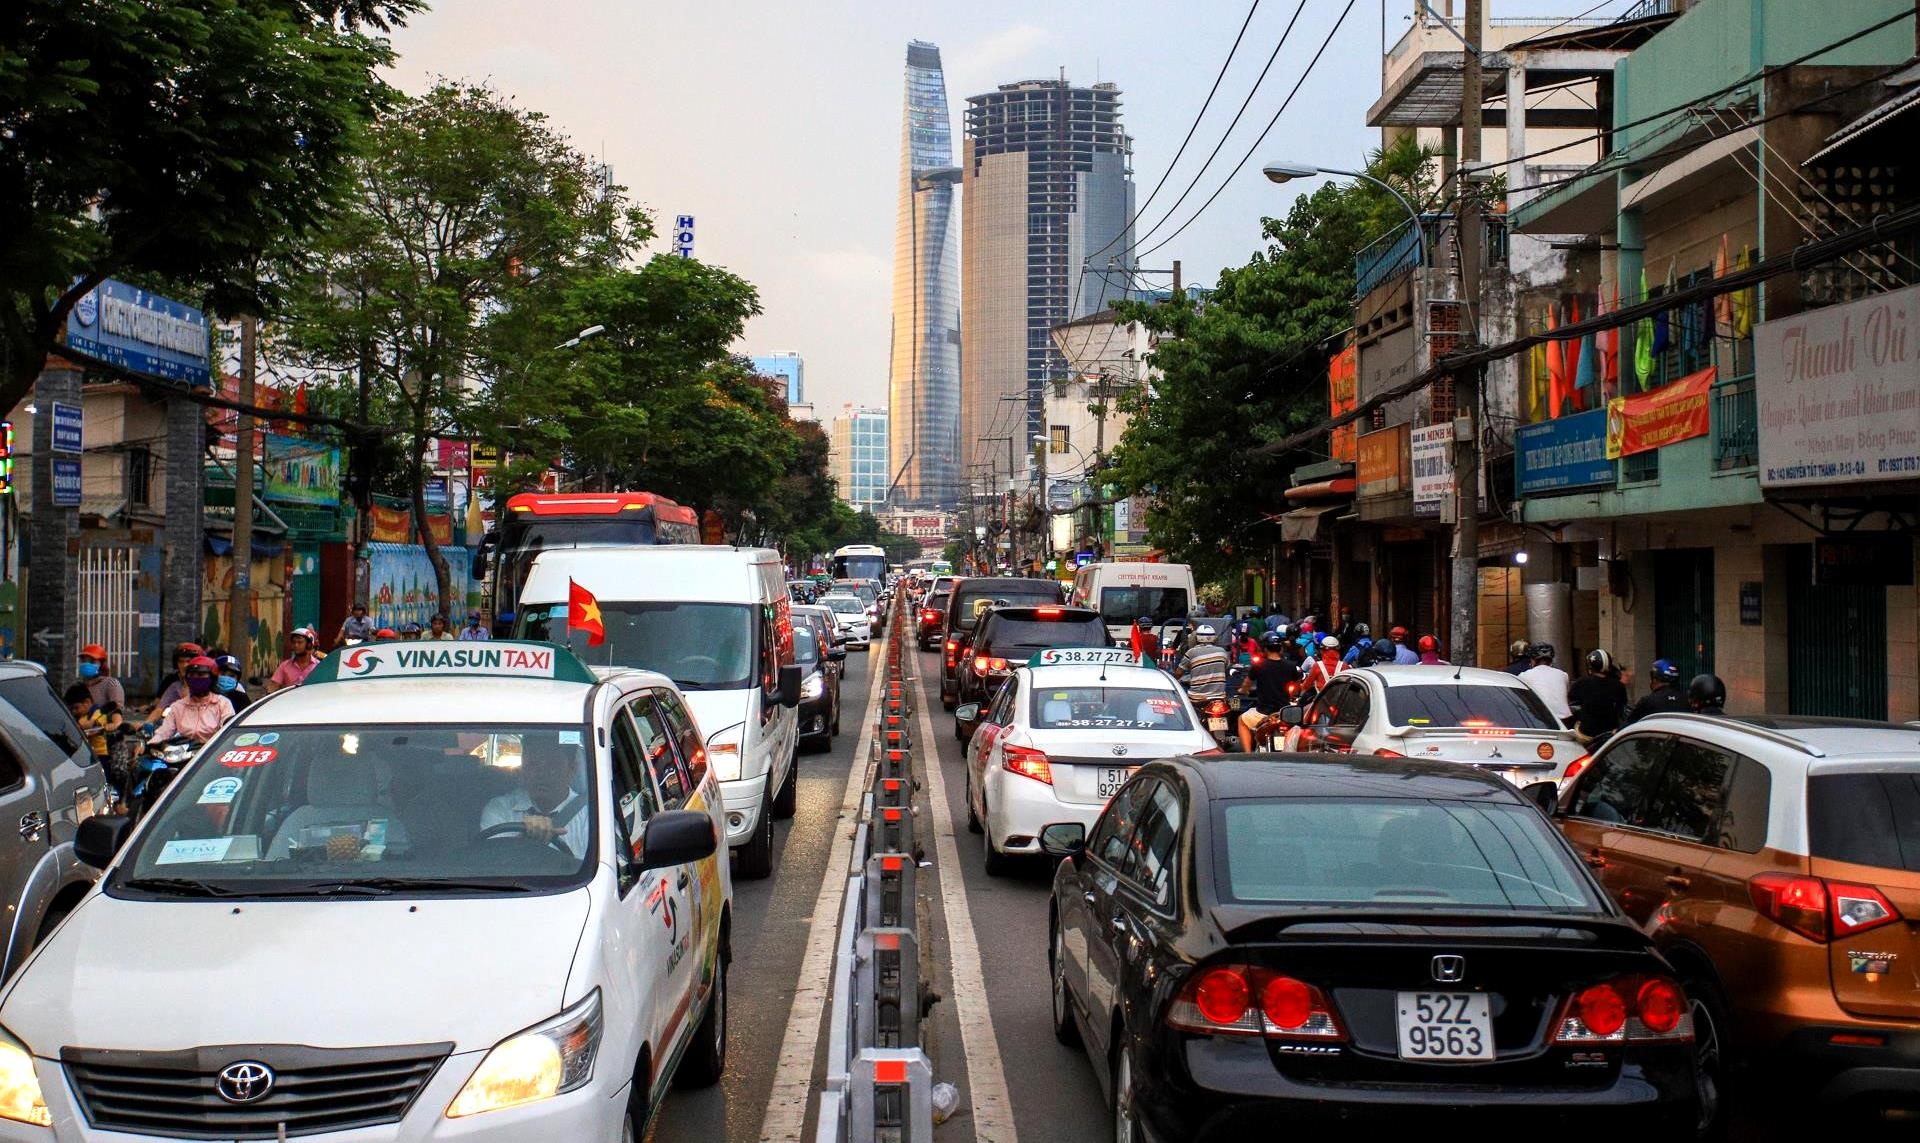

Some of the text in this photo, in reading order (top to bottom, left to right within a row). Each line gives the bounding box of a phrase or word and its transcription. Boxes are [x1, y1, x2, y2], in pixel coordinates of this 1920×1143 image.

[1782, 316, 1855, 384] Thanh
[1106, 652, 1123, 662] 27
[1124, 653, 1132, 662] 2
[220, 751, 272, 762] 8613
[1847, 950, 1898, 960] SUZUKI
[1416, 995, 1471, 1025] 52Z
[1409, 1025, 1483, 1056] 9563
